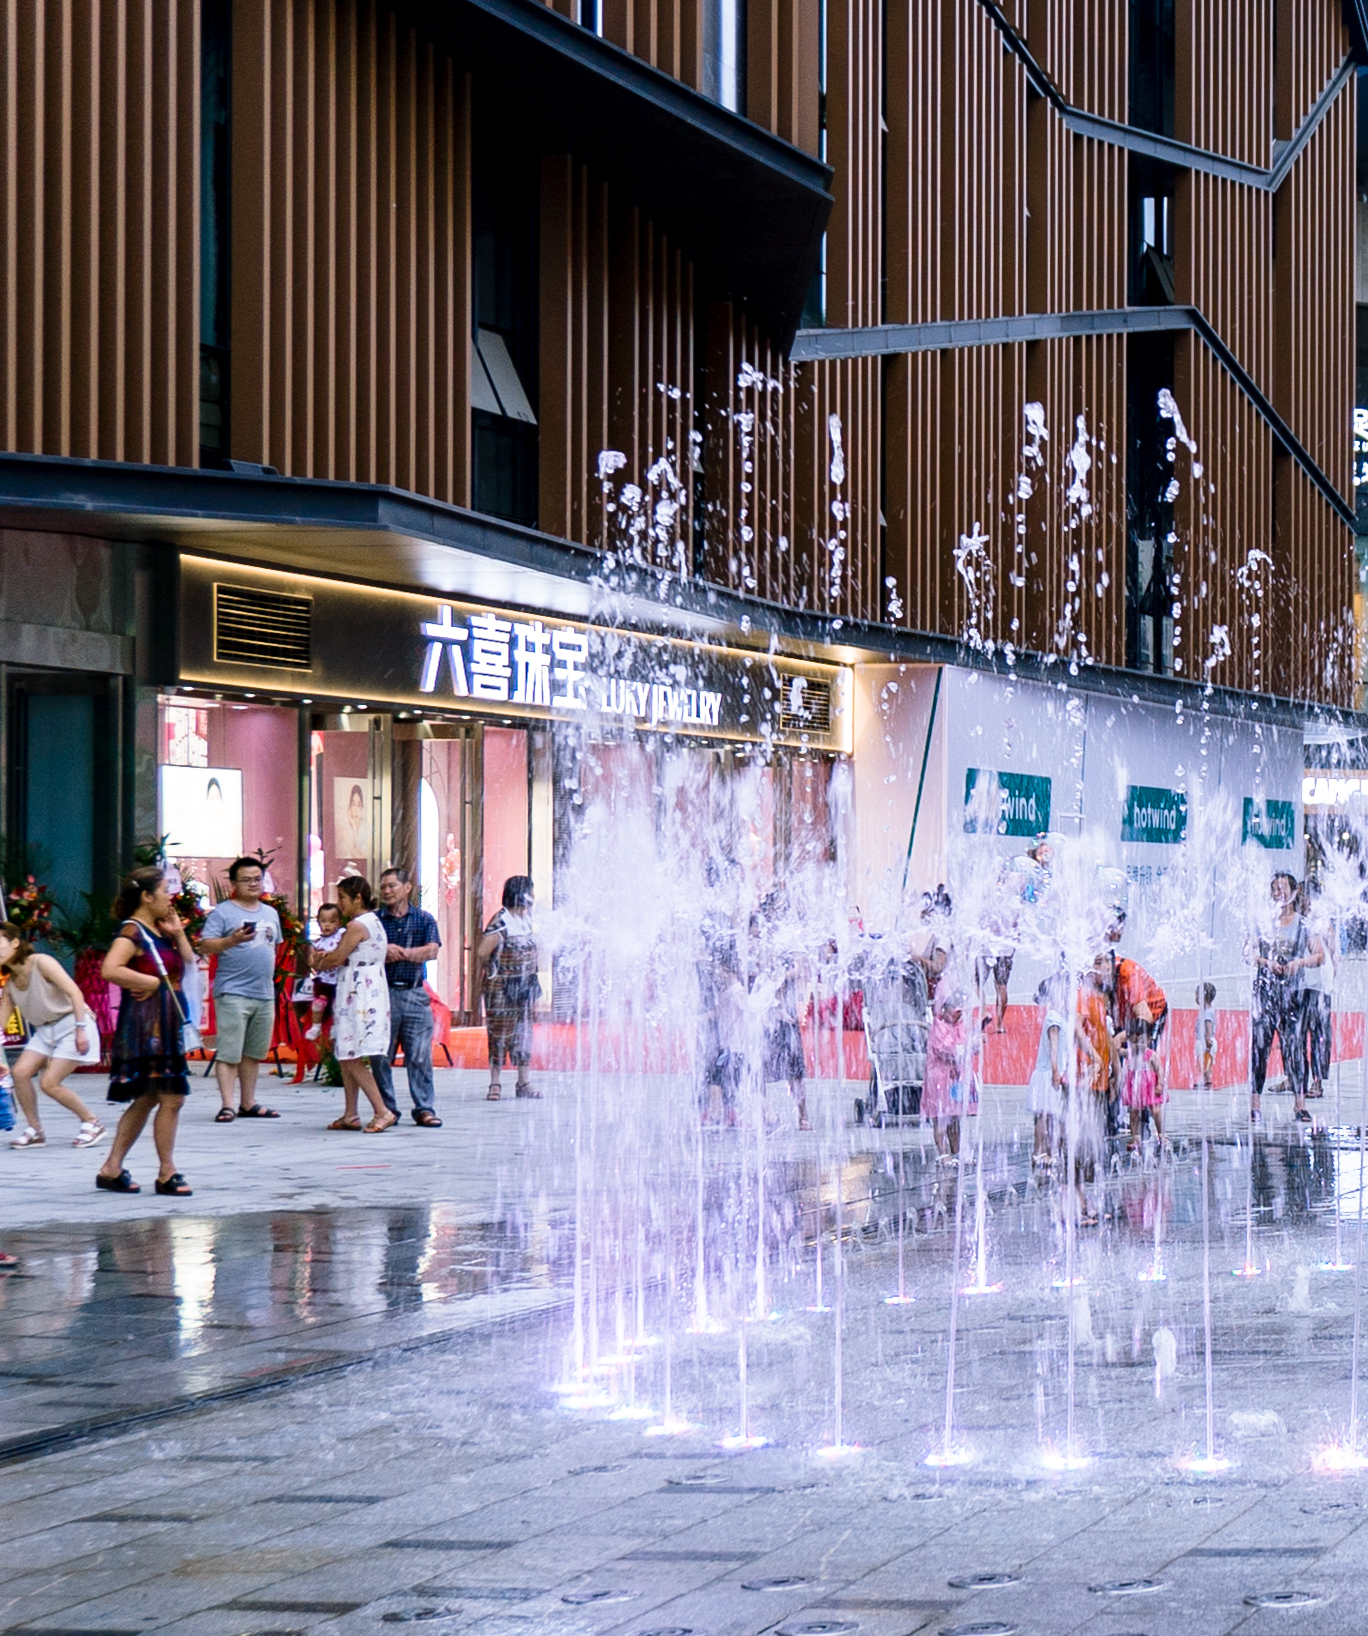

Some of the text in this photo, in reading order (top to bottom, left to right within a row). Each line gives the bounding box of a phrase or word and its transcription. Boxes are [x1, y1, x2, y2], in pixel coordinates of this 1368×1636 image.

[420, 603, 589, 711] 六喜珠宝
[651, 683, 722, 727] JEWELRY
[1133, 800, 1177, 830] hotwind
